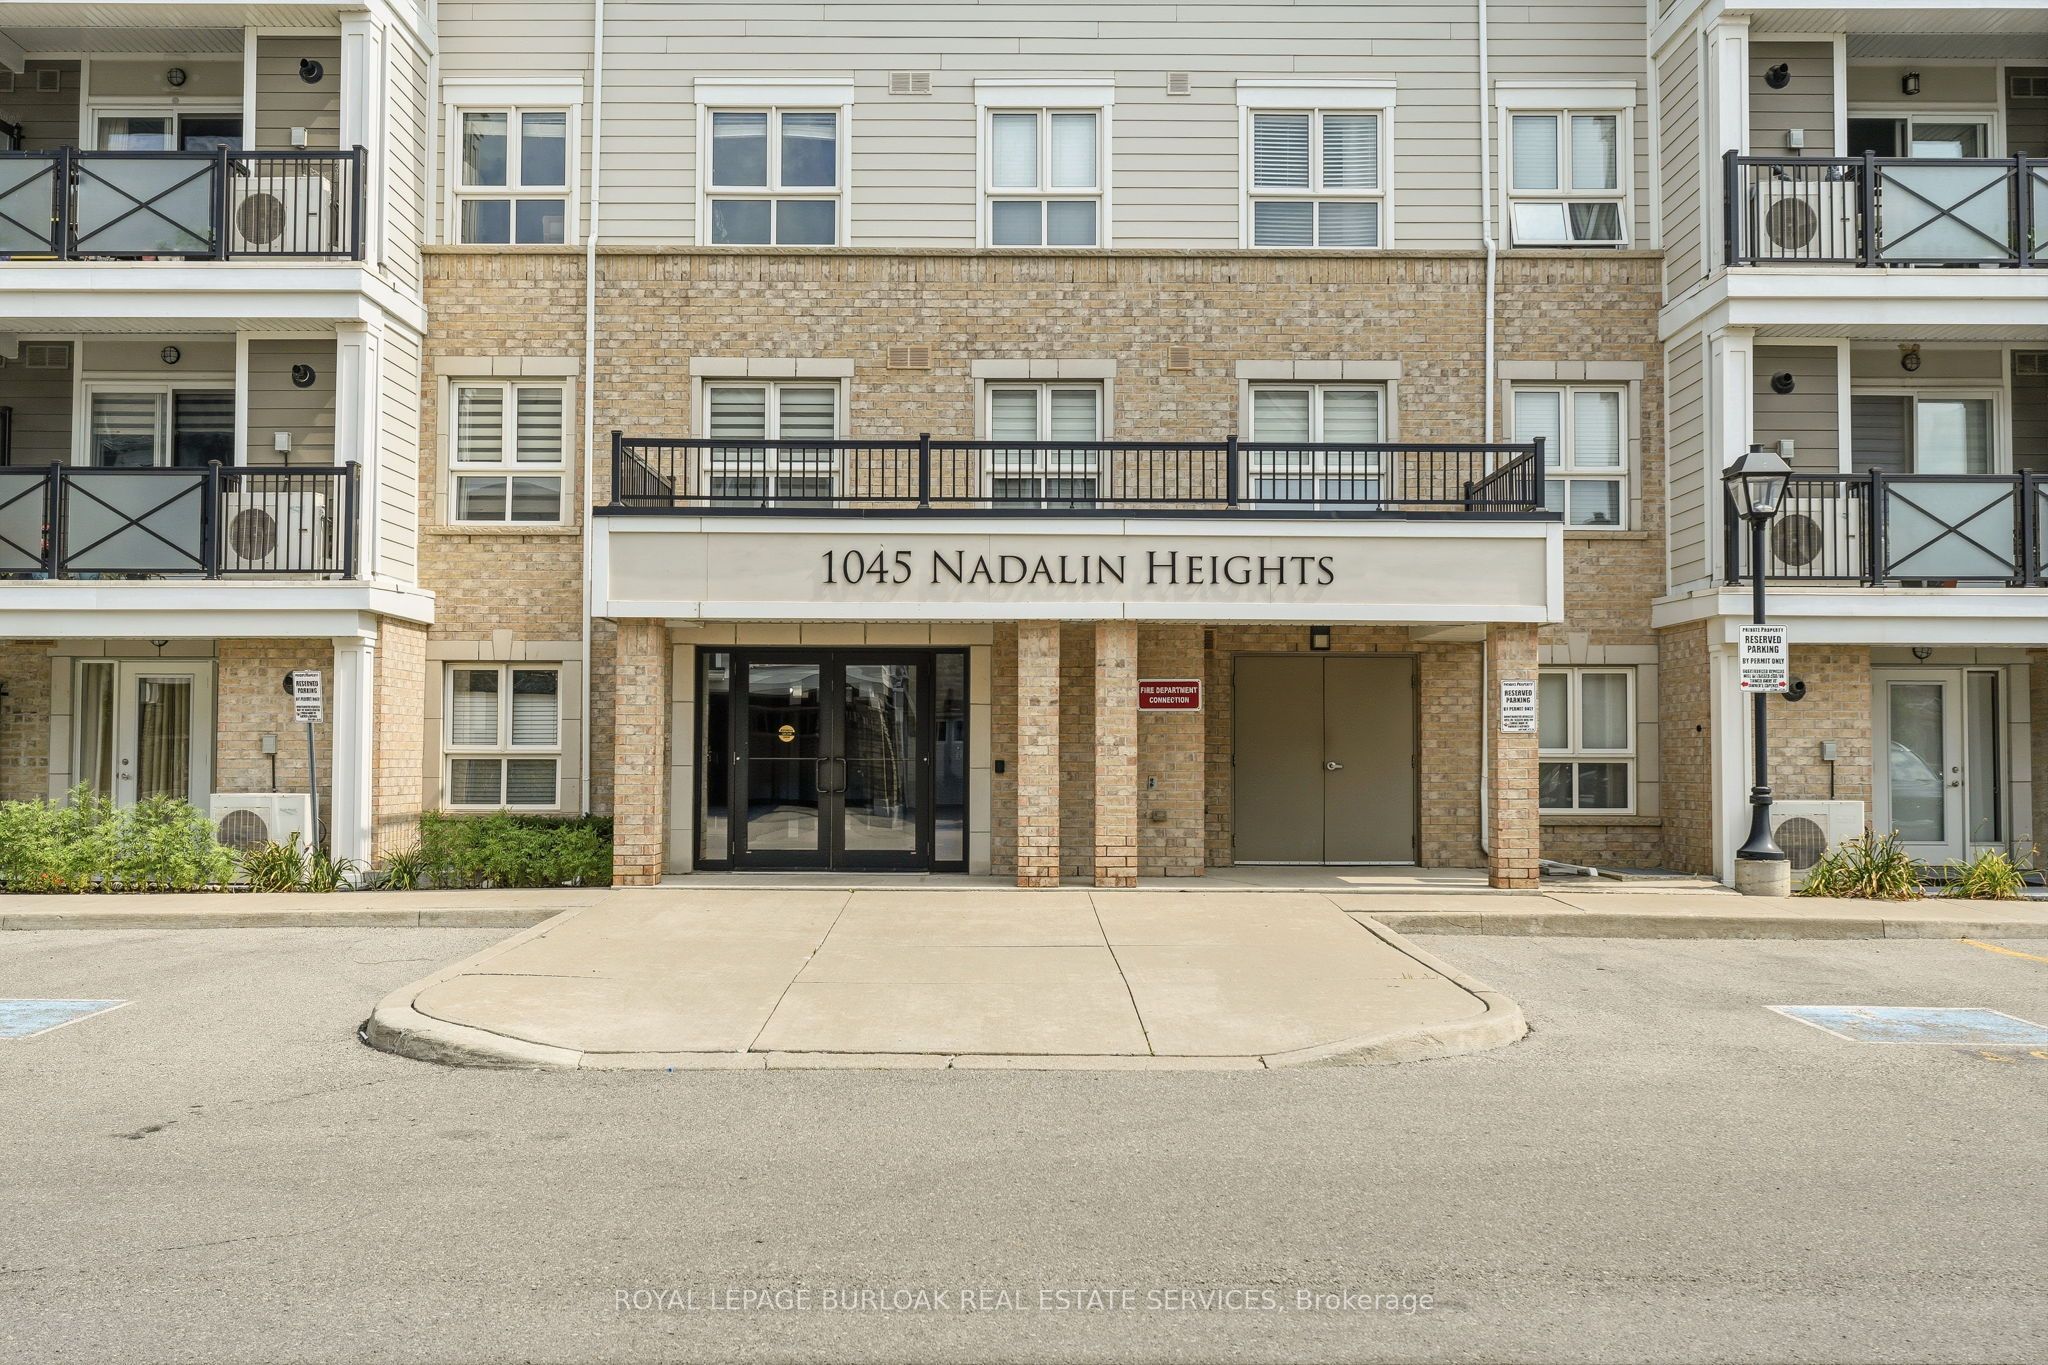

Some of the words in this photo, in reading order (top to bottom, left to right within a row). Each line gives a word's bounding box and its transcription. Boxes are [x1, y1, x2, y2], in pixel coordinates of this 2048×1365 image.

[821, 549, 913, 586] 1045
[1745, 635, 1782, 644] RESERVED
[1747, 645, 1779, 654] PARKING
[1140, 686, 1154, 694] FIRE
[1155, 686, 1198, 694] DEPARTMENT
[1504, 689, 1533, 697] RESERVED
[1149, 696, 1190, 704] CONNECTION
